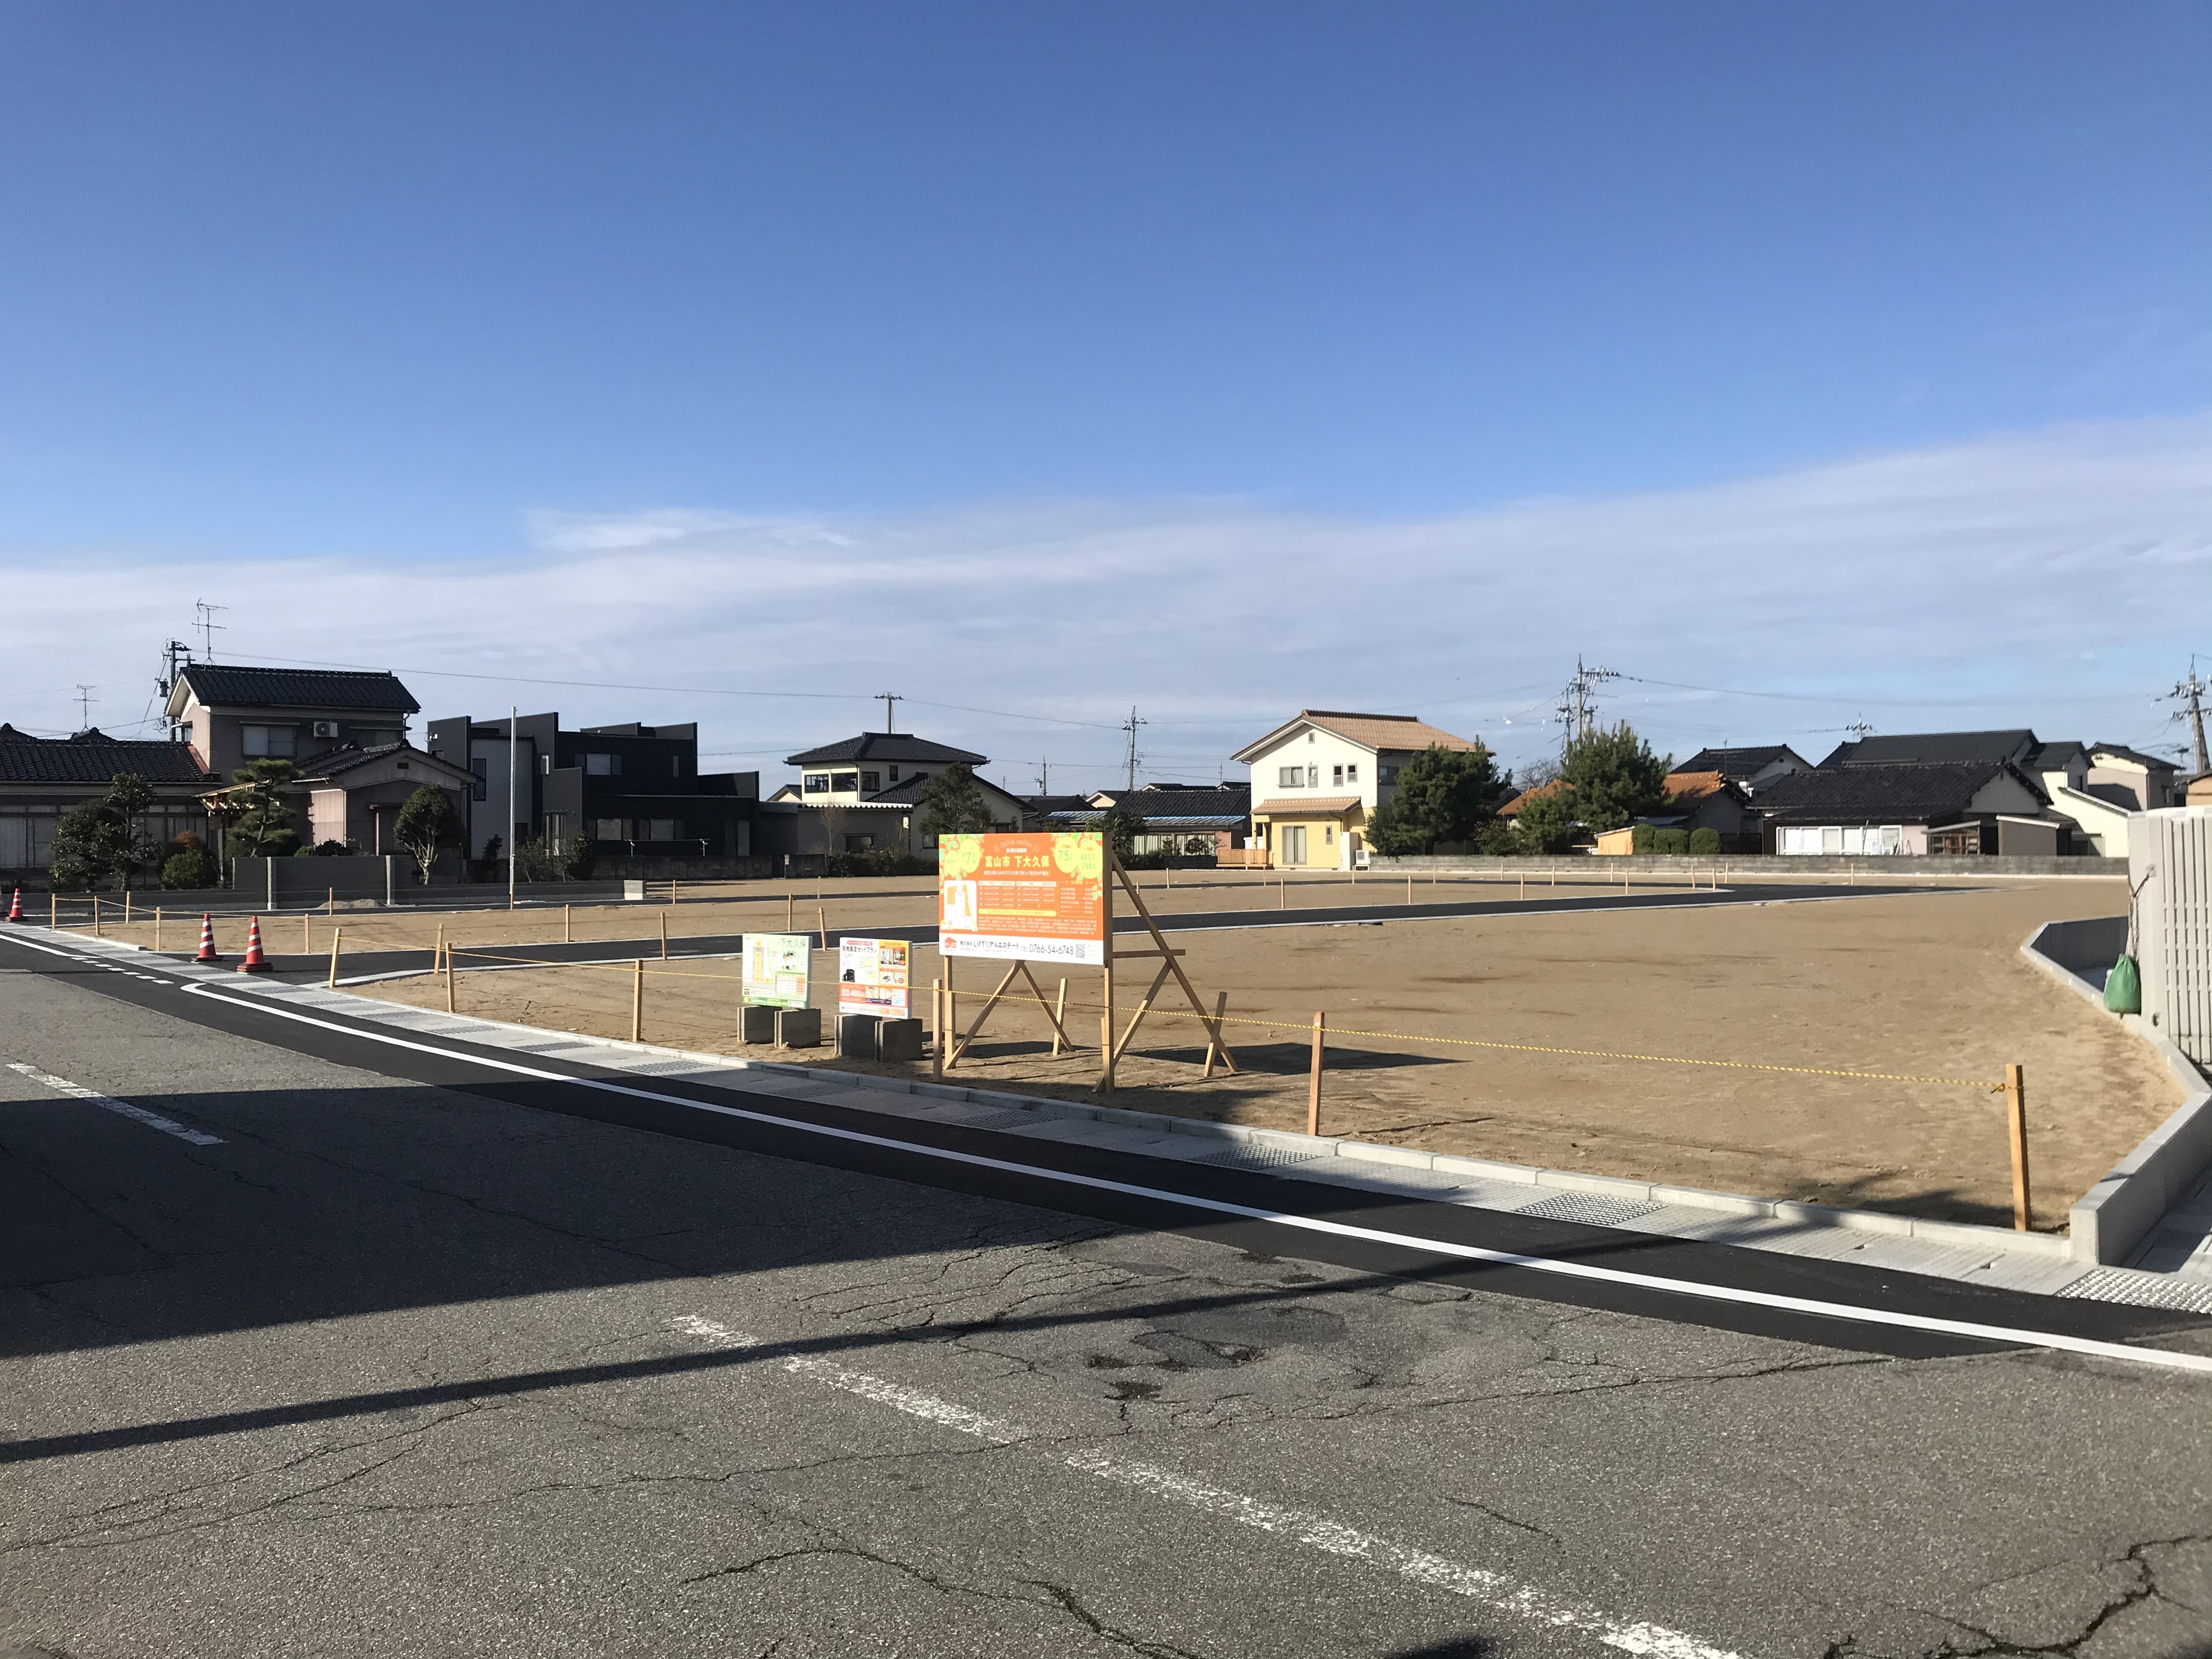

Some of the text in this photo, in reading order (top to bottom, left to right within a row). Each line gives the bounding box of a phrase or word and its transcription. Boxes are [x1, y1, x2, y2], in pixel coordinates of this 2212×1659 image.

[985, 855, 1010, 867] 富山市
[1014, 855, 1049, 867] 下大久保
[780, 938, 806, 948] 下大久保
[974, 941, 1019, 949] LIFTリアルエステート
[1029, 944, 1074, 955] 0766-54-6748
